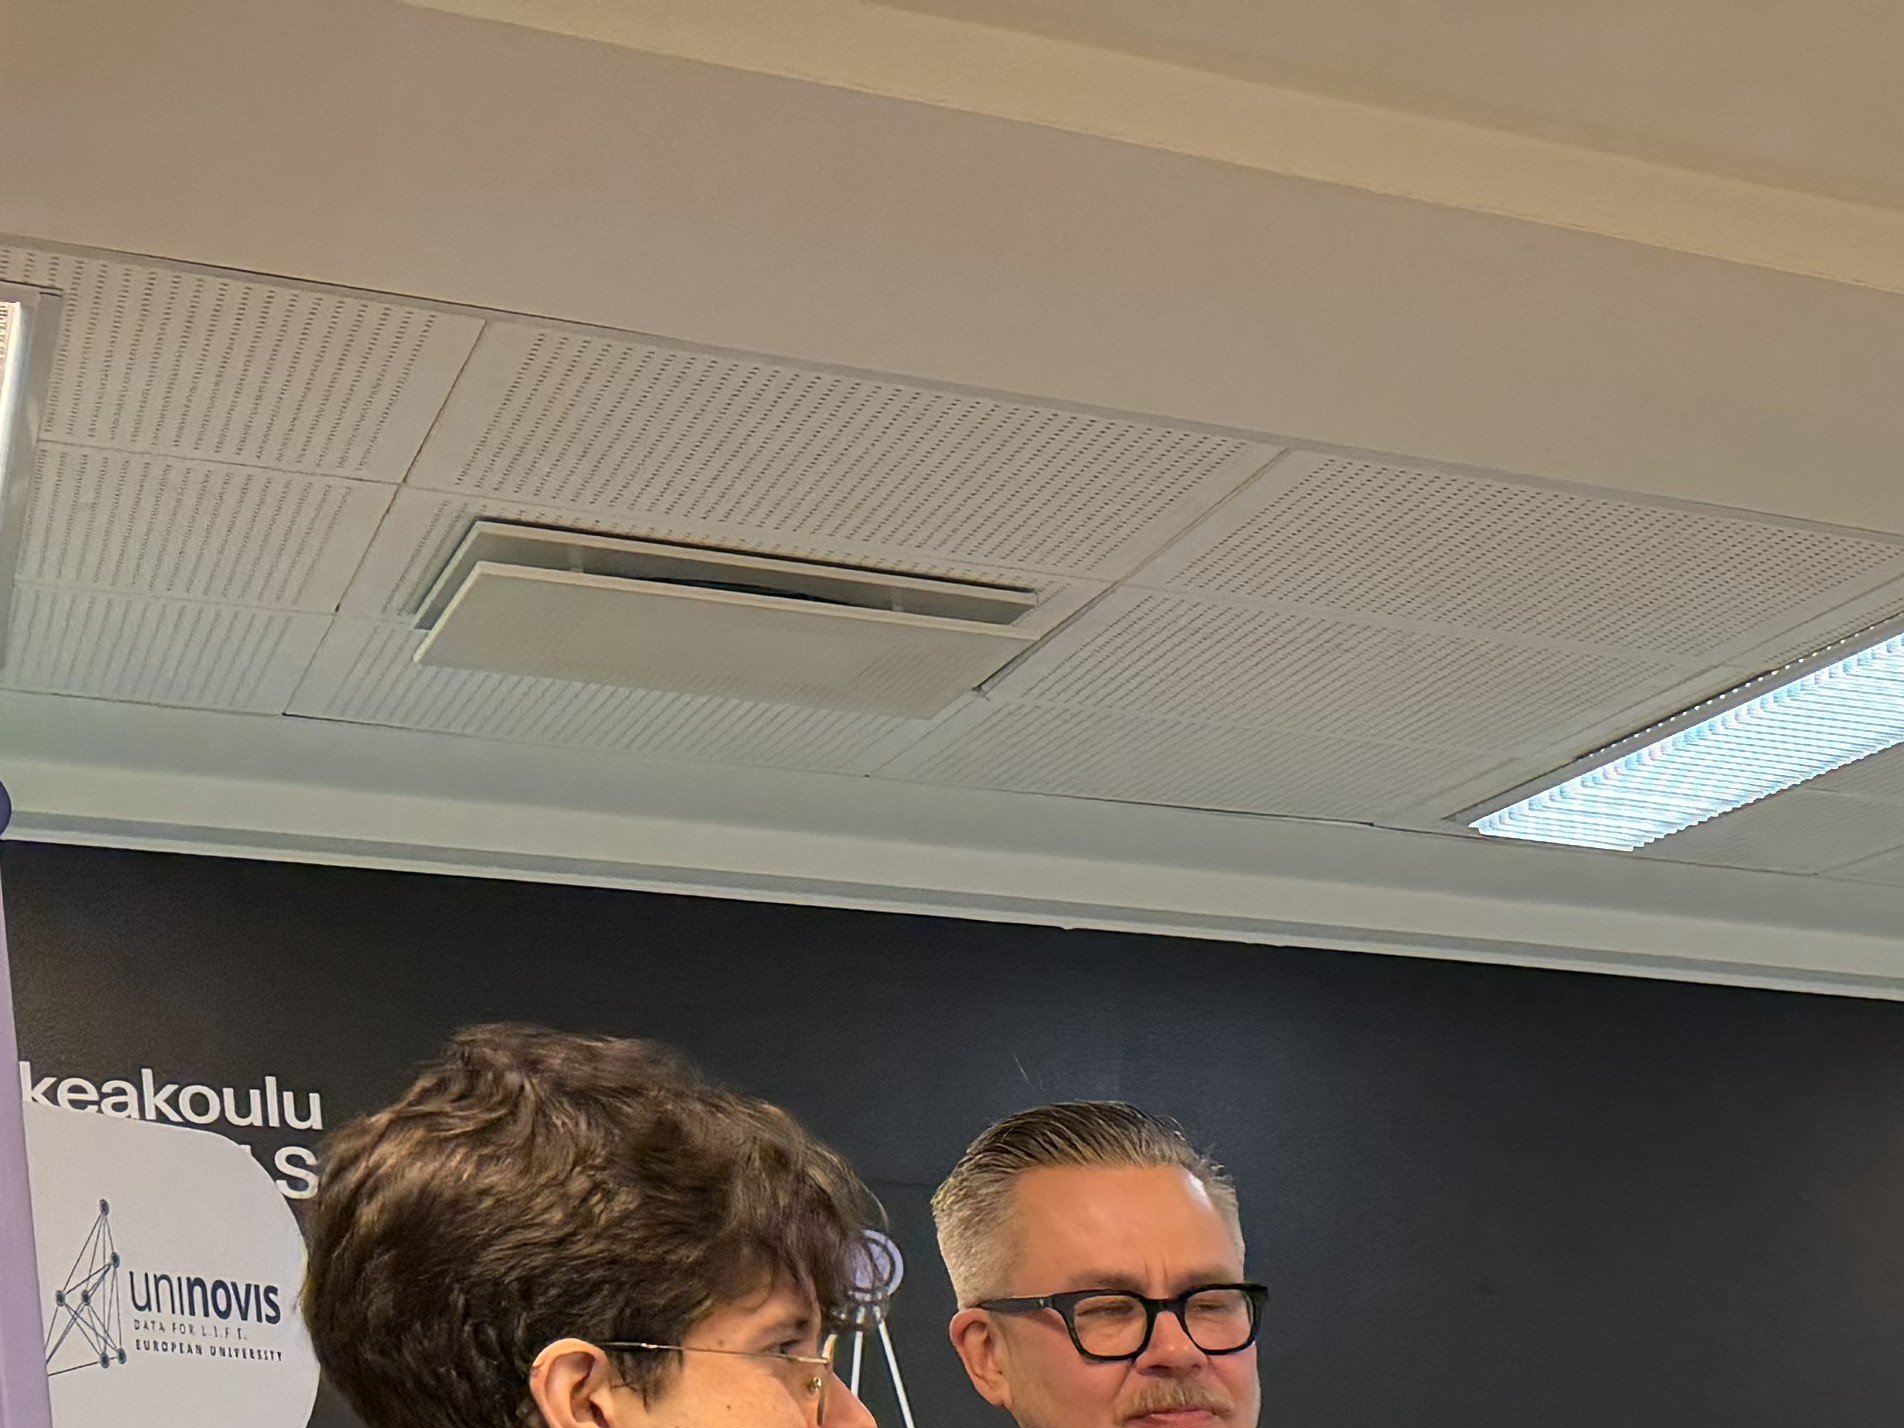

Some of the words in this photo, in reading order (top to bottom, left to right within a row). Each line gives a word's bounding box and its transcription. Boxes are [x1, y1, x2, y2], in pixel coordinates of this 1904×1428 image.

[128, 1270, 281, 1325] uninovis
[135, 1339, 203, 1356] EUROPEAN
[209, 1345, 283, 1362] UNIVERSITY
